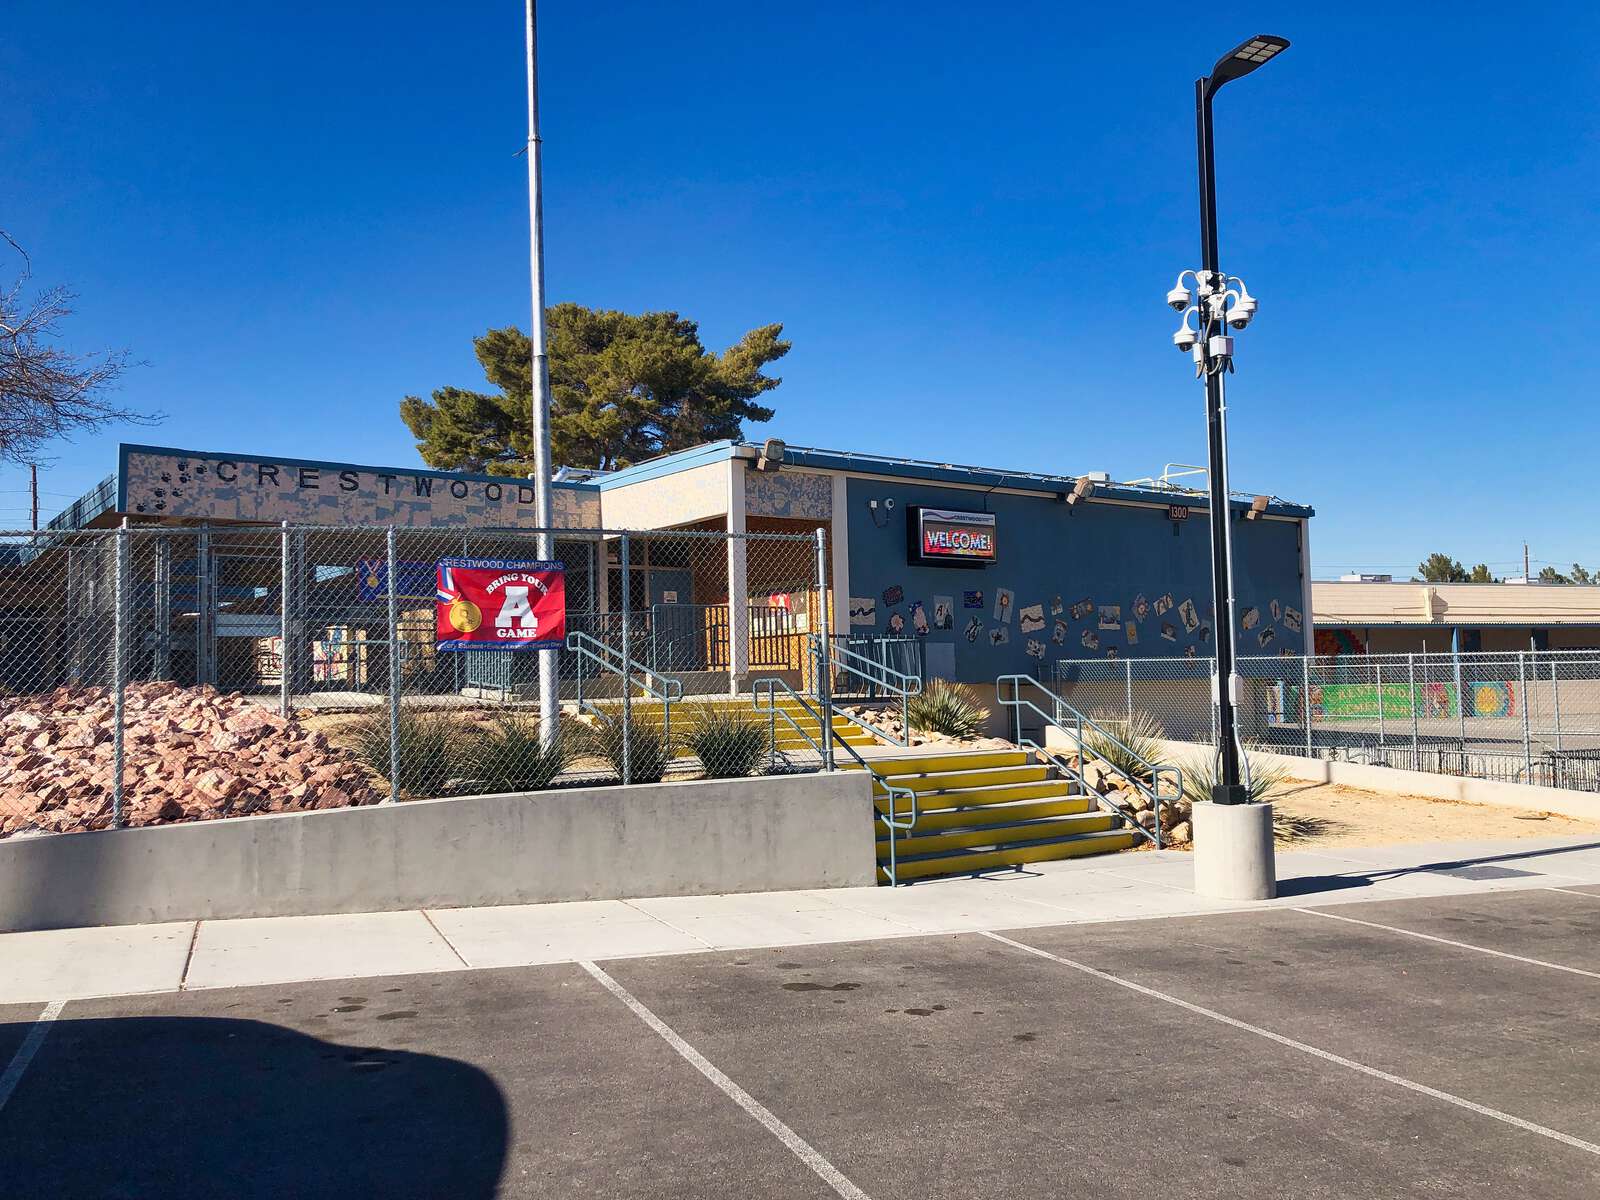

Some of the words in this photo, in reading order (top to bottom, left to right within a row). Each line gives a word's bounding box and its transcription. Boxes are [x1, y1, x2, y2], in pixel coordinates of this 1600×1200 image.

[217, 460, 536, 504] CRESTWOOD
[1171, 506, 1187, 518] 1300
[927, 531, 991, 550] WELCOME!
[506, 560, 563, 570] CHAMPIONS
[486, 573, 518, 595] BRING
[521, 573, 548, 596] YOUR
[495, 586, 538, 628] A
[496, 628, 537, 638] GAME
